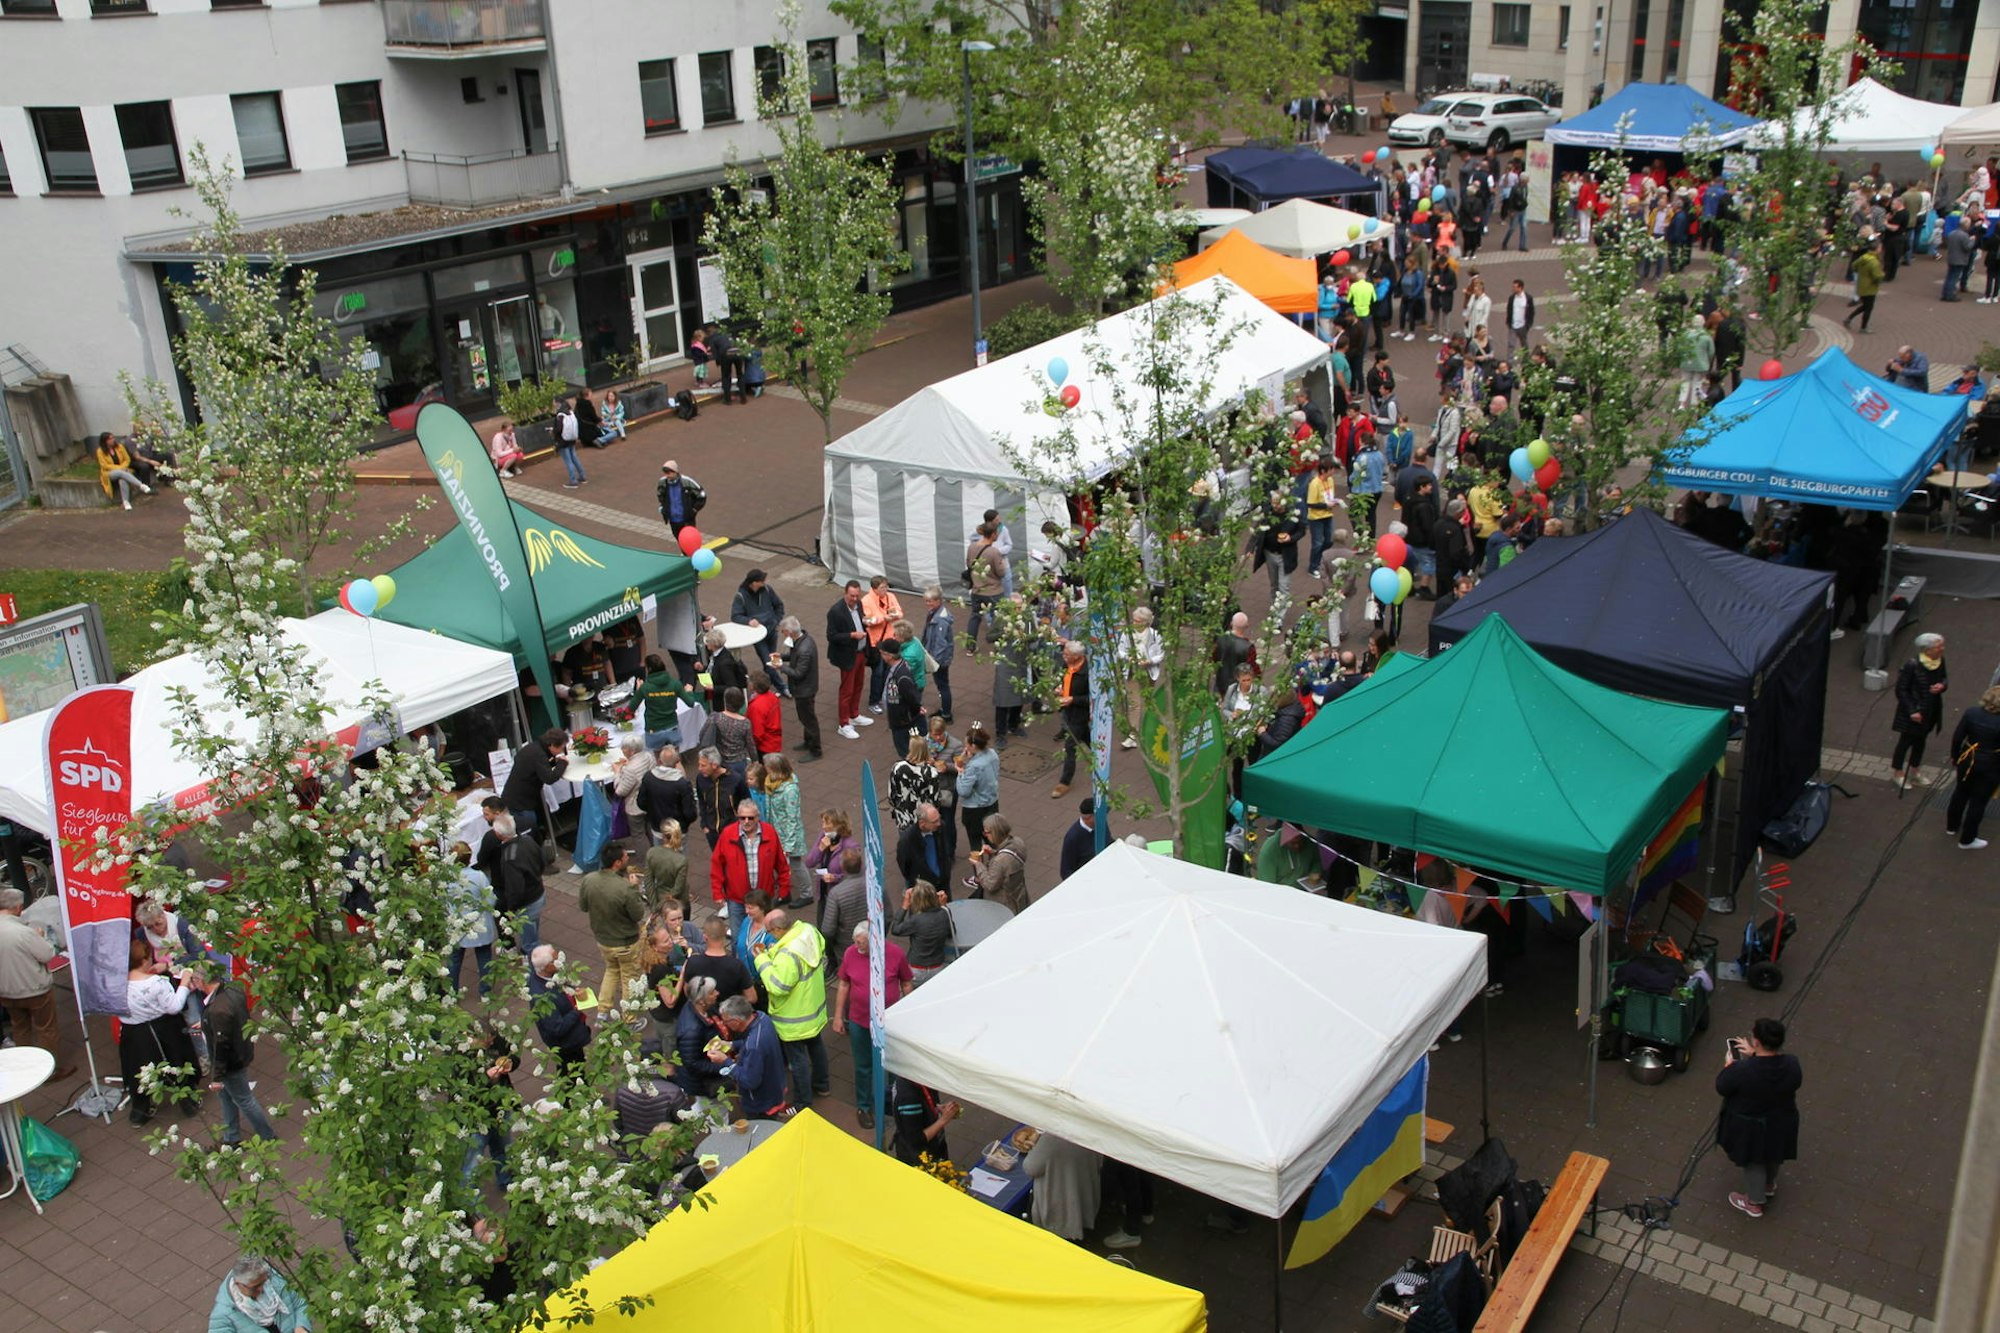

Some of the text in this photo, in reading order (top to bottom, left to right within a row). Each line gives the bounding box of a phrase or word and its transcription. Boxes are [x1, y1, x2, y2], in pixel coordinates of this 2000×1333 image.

[1730, 472, 1755, 483] CDU
[1770, 476, 1788, 487] DIE
[1791, 479, 1888, 498] SIEGBURGPARTEI
[568, 599, 639, 640] PROVINZIAL
[14, 625, 57, 642] Information
[60, 760, 122, 793] SPD
[183, 788, 208, 806] ALLES
[63, 819, 86, 837] für
